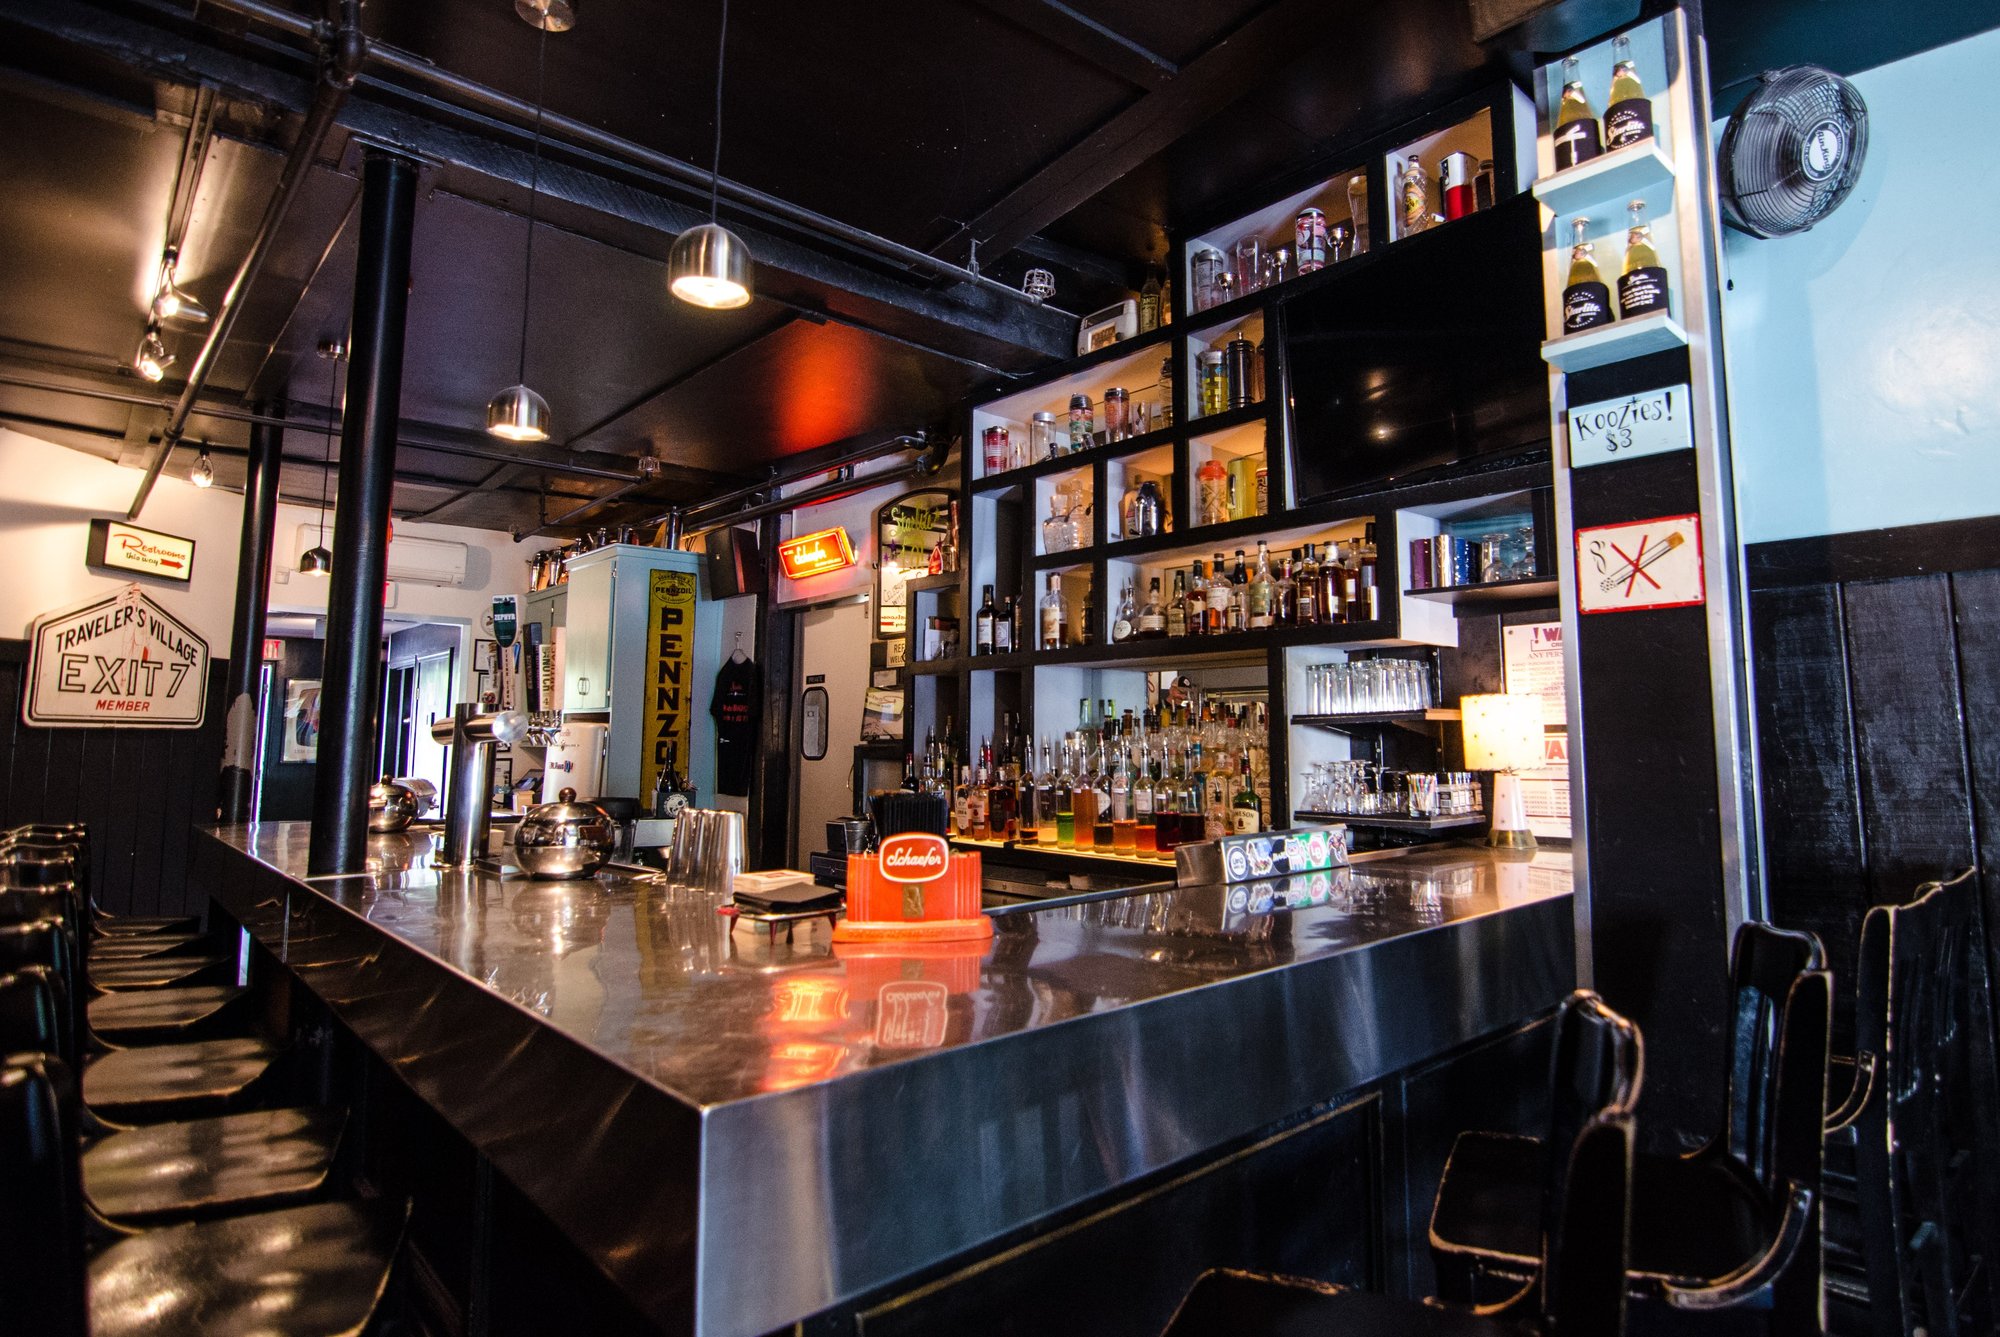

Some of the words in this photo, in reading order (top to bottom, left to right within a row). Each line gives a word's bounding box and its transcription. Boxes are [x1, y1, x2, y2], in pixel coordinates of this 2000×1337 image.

[1606, 428, 1633, 455] $3
[113, 533, 186, 560] Restrooms
[126, 552, 140, 561] this
[142, 557, 159, 566] way
[494, 613, 516, 621] ZEPHYR
[56, 605, 147, 653] TRAVELER'S
[150, 615, 198, 667] VILLAGE
[58, 653, 163, 697] EXIT
[166, 663, 190, 698] 7
[655, 606, 683, 778] PENNZO
[95, 700, 150, 712] MEMBER
[886, 846, 941, 868] Schaefer
